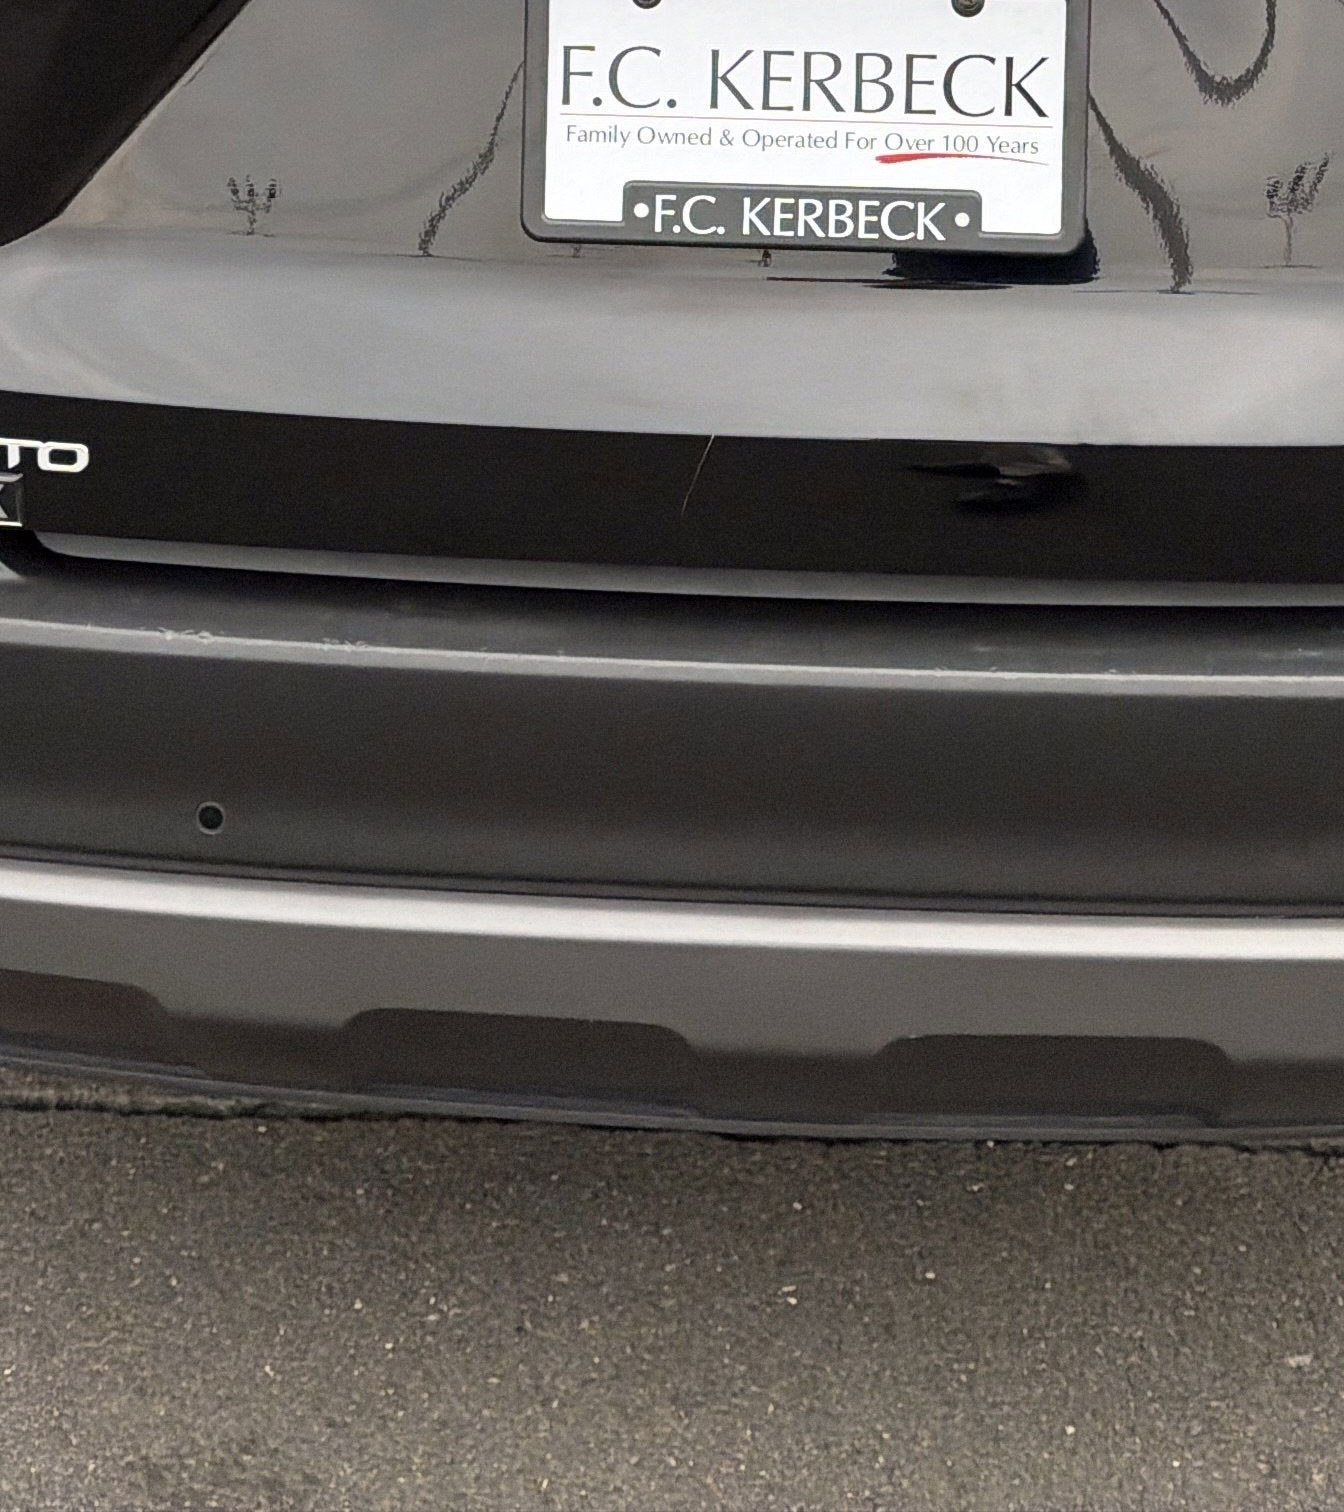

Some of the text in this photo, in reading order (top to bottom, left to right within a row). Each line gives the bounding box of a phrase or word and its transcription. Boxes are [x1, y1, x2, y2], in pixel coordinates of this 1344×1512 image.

[560, 44, 1050, 119] F.C. KERBECK
[566, 124, 1039, 155] Family Owned & Operated For Over 100 Years
[653, 194, 947, 242] F.C. KERBECK
